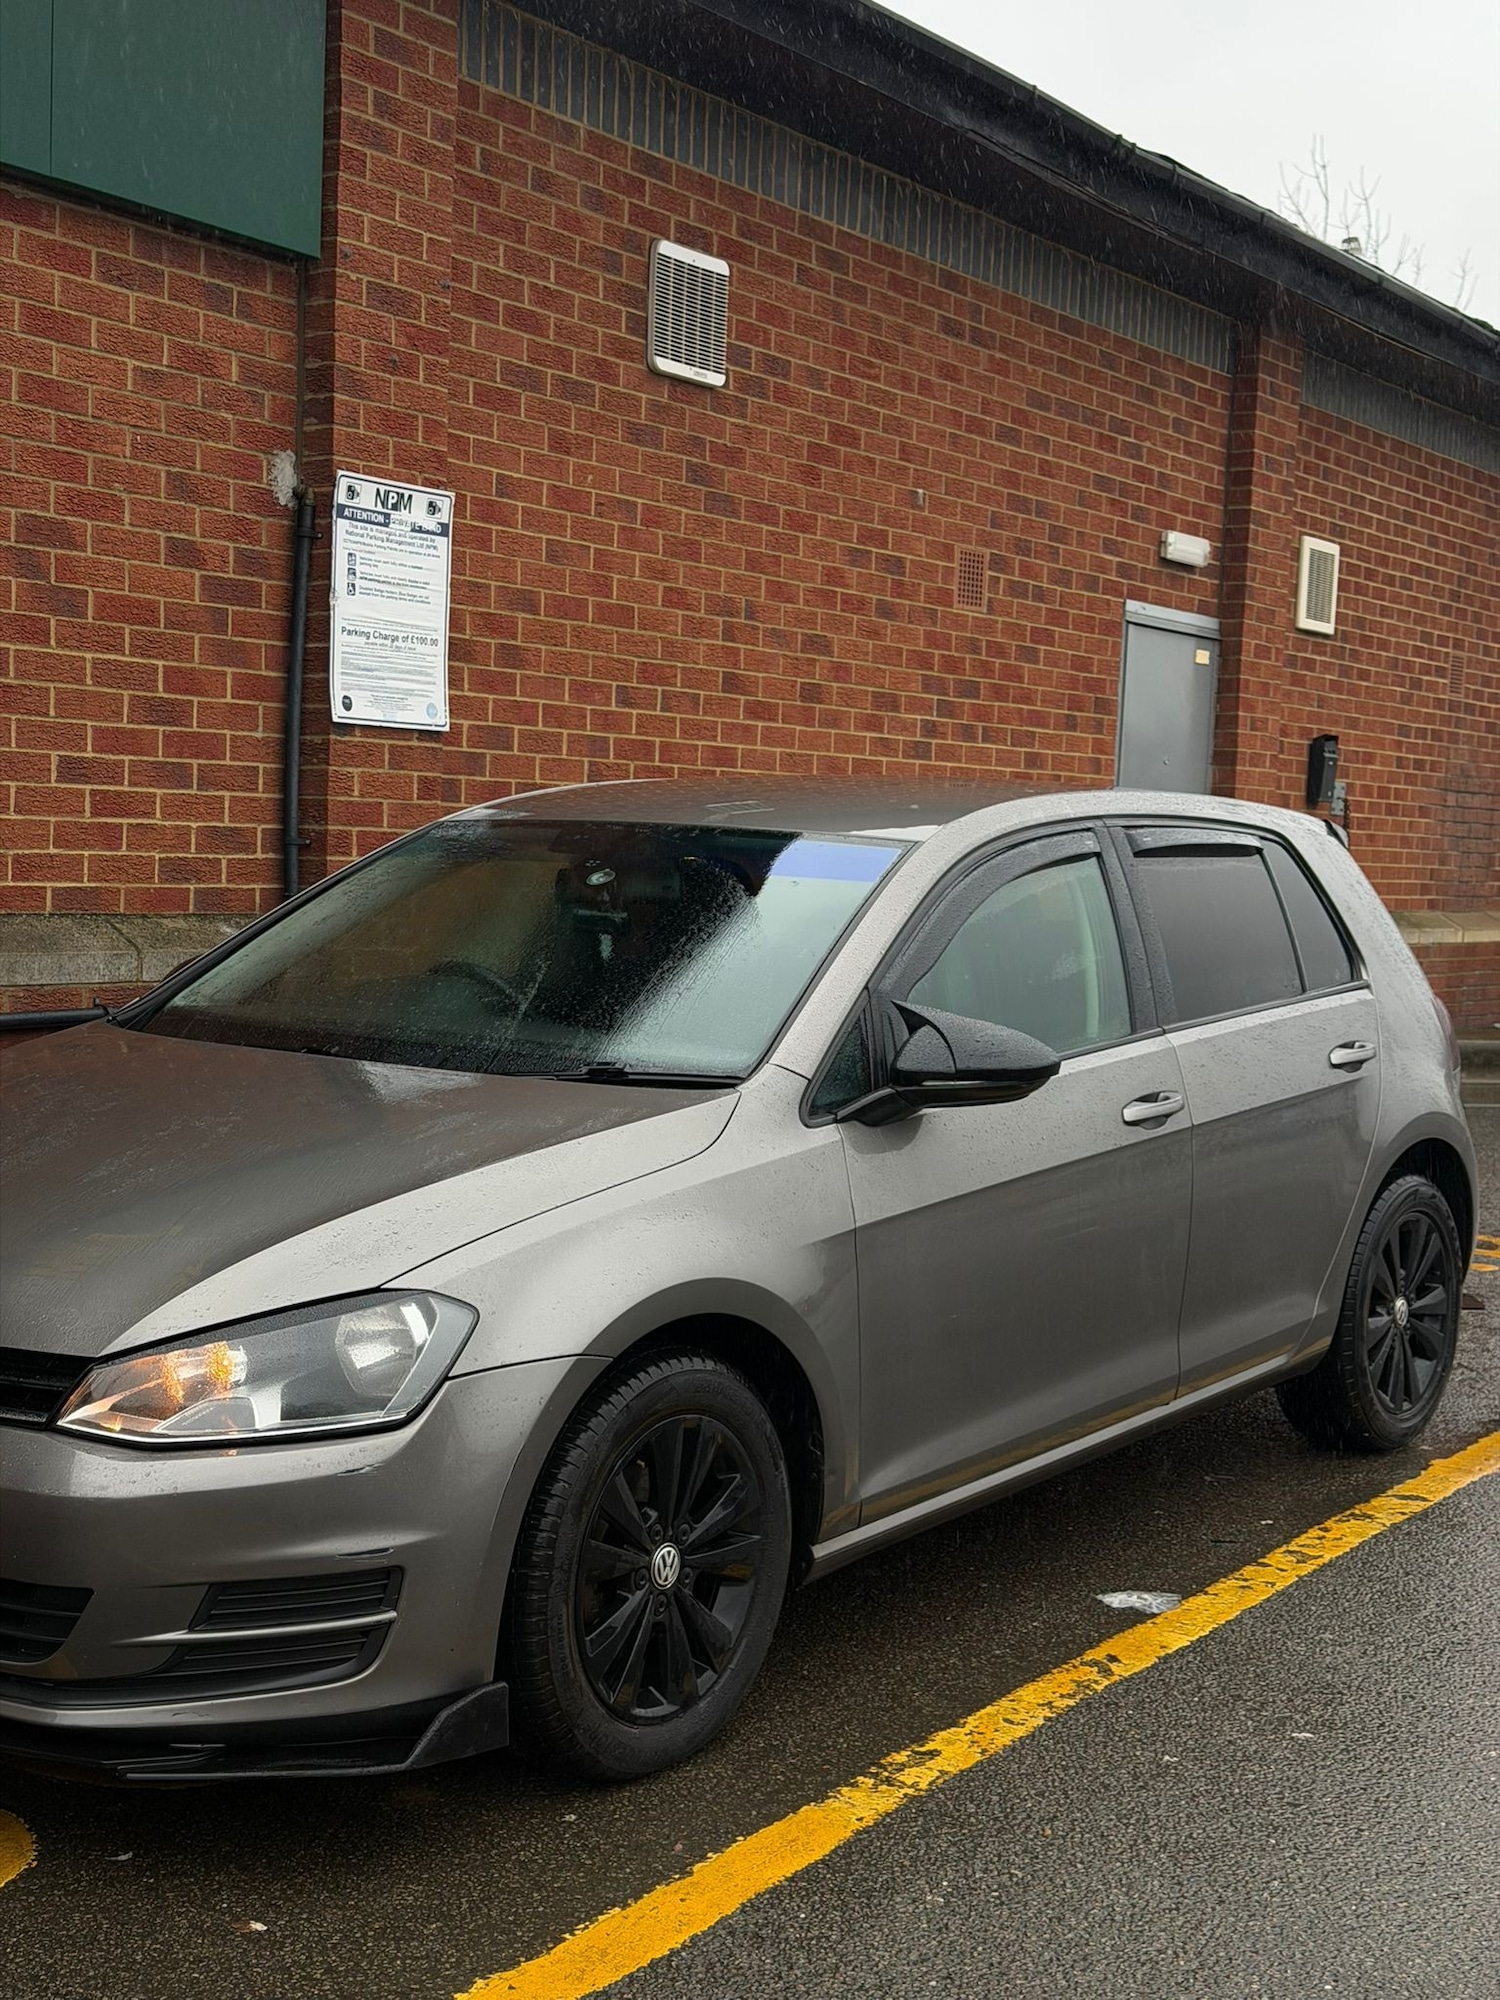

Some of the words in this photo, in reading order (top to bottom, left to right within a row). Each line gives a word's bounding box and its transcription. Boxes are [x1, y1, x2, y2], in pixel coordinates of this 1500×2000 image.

[374, 487, 413, 514] NPM
[343, 507, 385, 523] ATTENTION
[341, 626, 371, 640] Parking
[372, 630, 400, 644] Charge
[402, 634, 410, 643] of
[410, 636, 439, 647] £100.00
